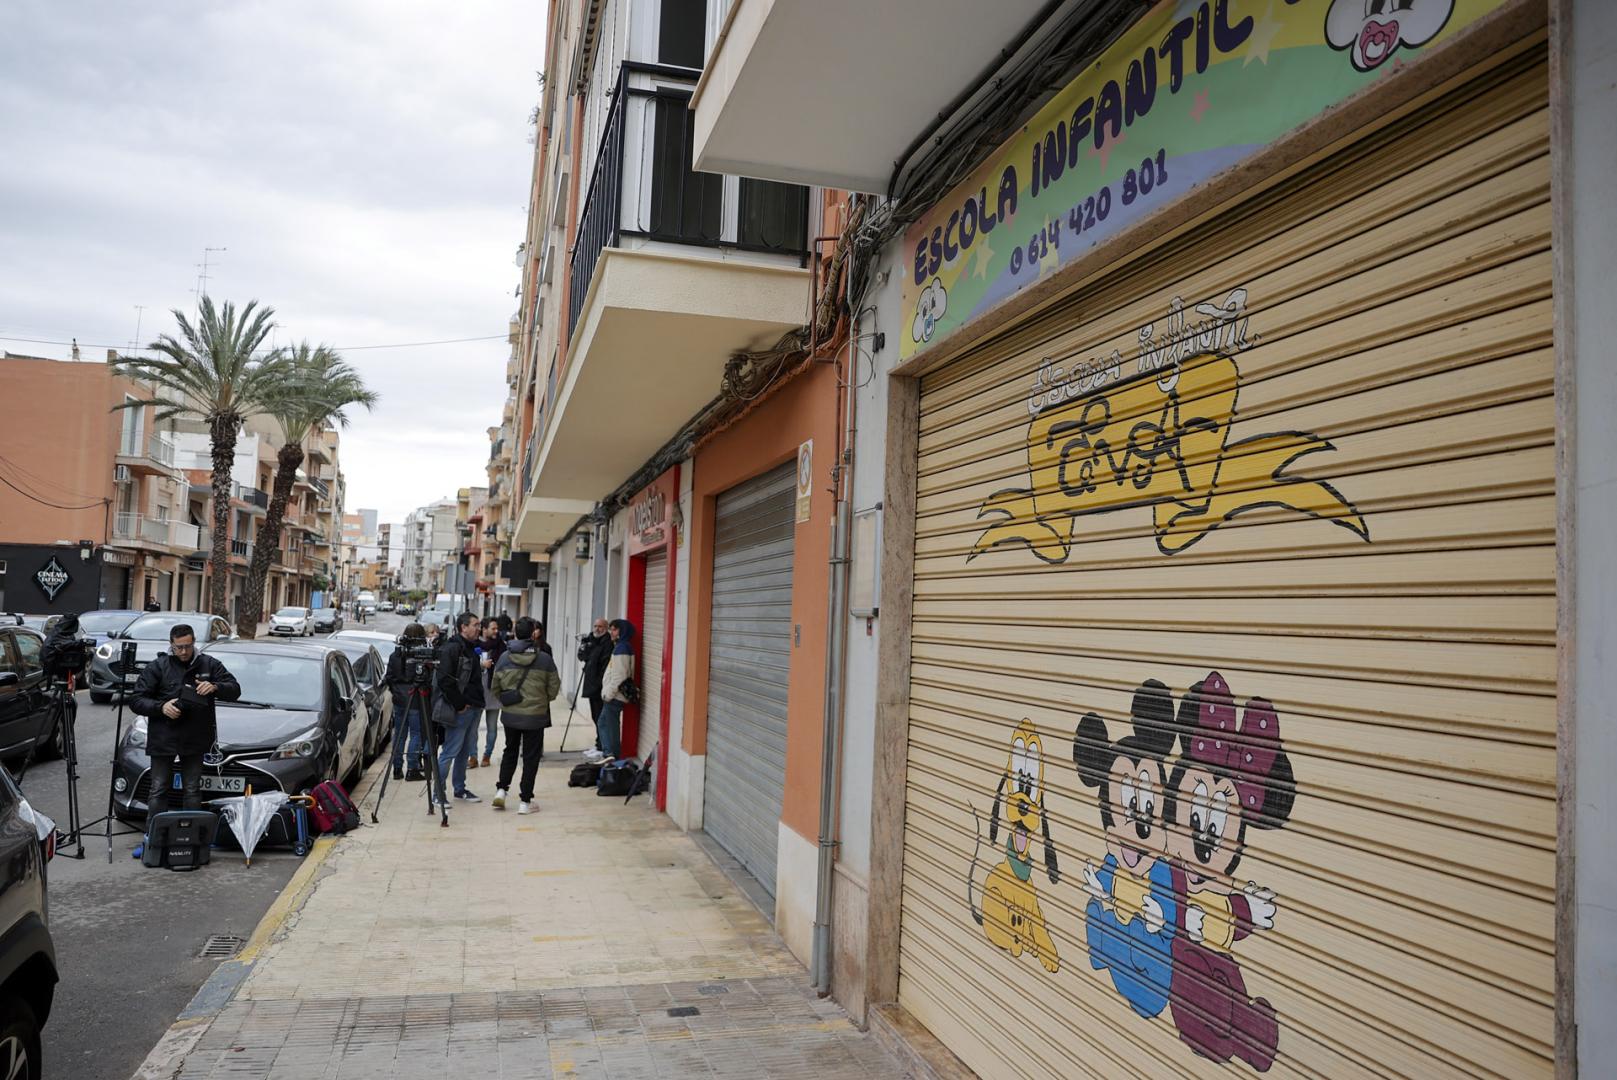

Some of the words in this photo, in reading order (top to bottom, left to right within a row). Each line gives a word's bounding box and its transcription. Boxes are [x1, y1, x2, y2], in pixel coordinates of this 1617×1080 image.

[914, 165, 1018, 286] ESCOLA
[1031, 0, 1255, 197] INFANTIL
[1028, 219, 1060, 265] 614
[1069, 186, 1112, 236] 420
[1122, 148, 1169, 206] 801
[217, 779, 241, 790] JKS
